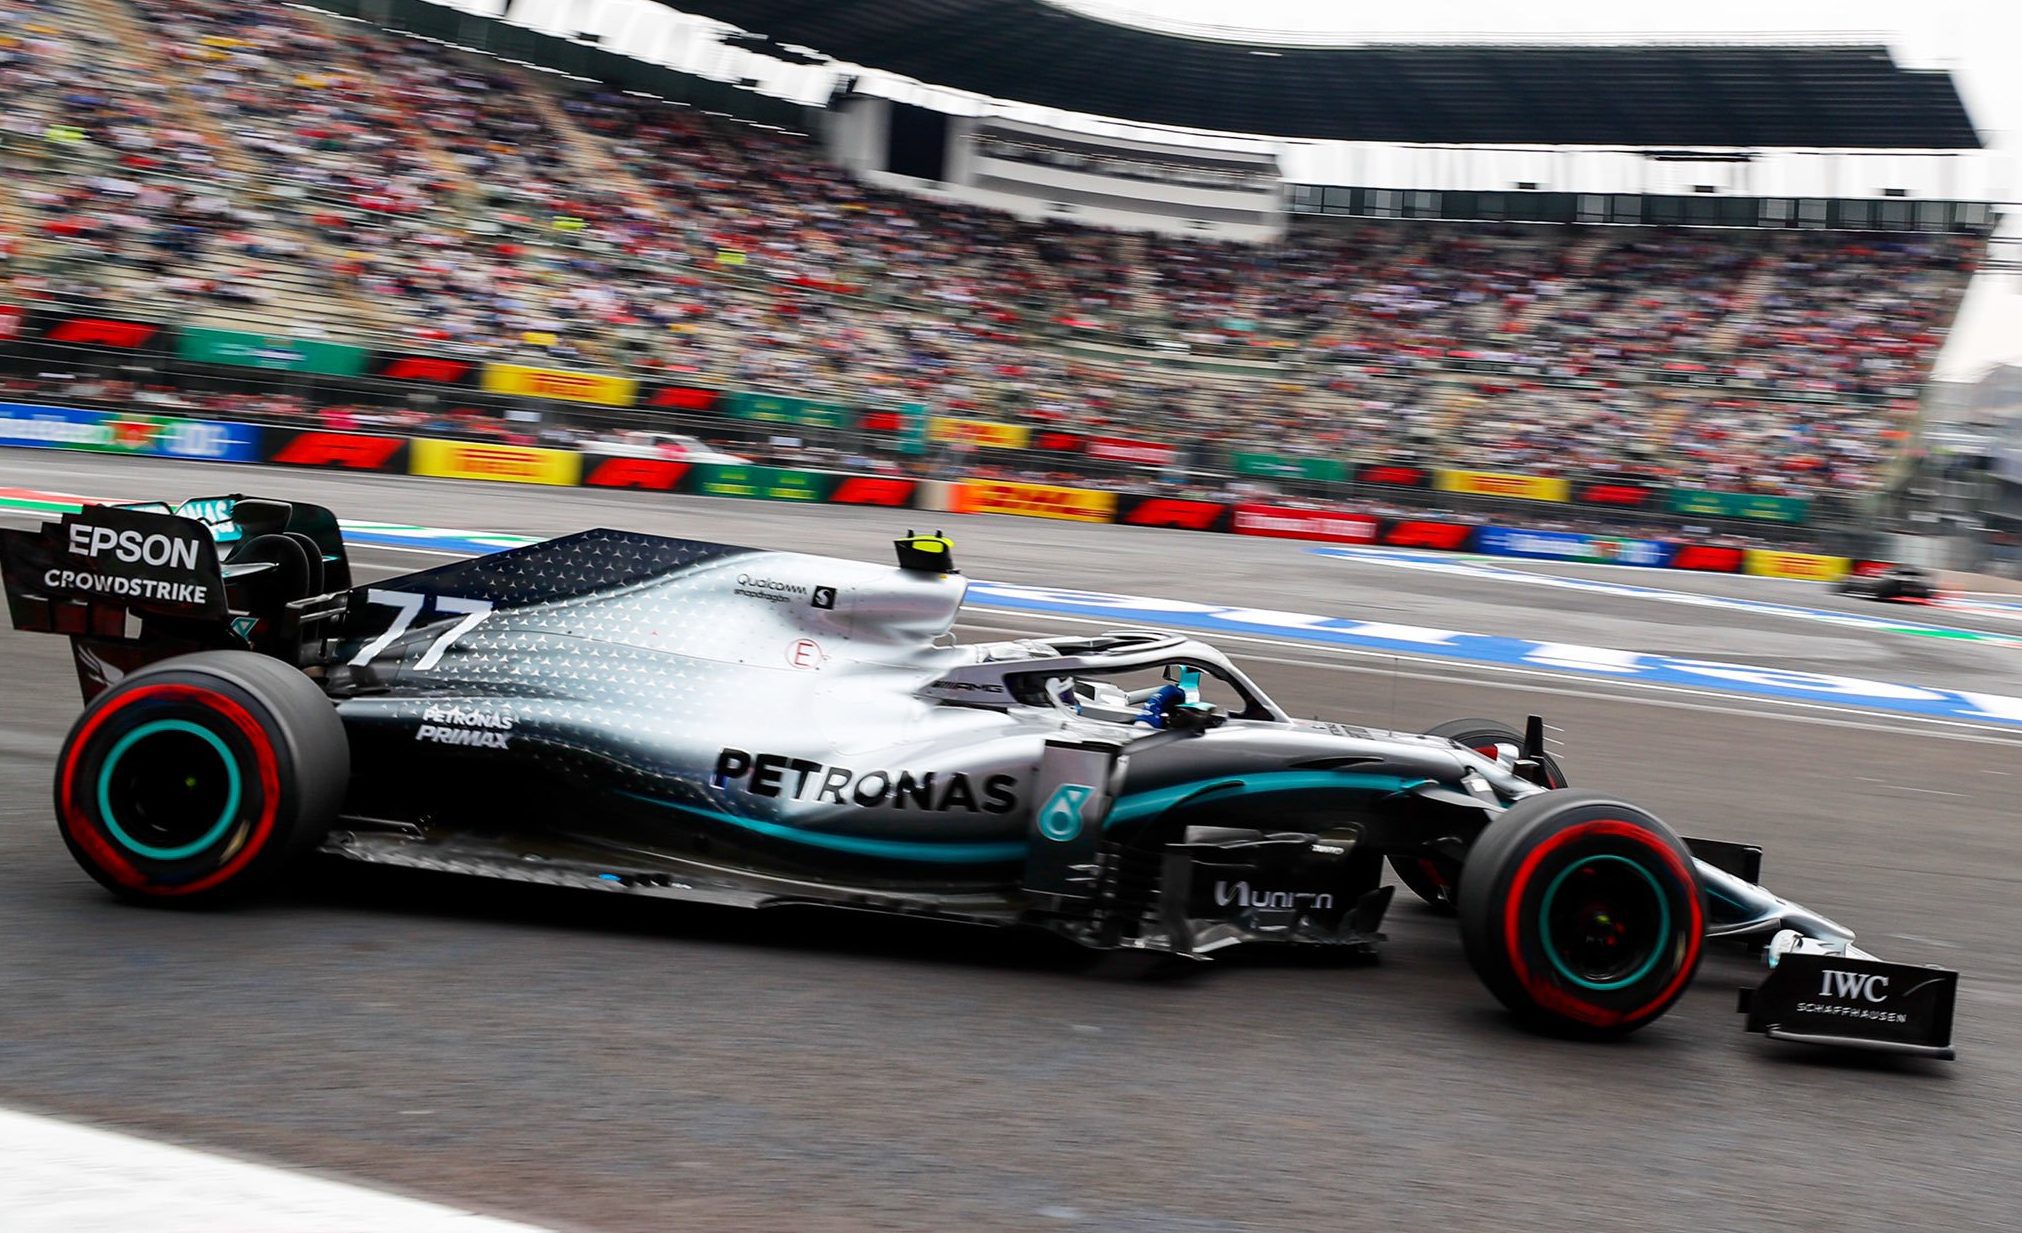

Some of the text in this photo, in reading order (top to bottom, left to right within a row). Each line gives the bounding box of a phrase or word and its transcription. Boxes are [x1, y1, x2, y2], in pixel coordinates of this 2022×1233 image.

[69, 523, 199, 570] EPSON
[44, 569, 207, 604] CROWDSTRIKE
[347, 588, 493, 671] 77
[794, 642, 815, 667] E
[423, 707, 514, 730] PETRONAS
[415, 725, 510, 750] PRIMAX
[711, 746, 1019, 815] PETRONAS
[1818, 969, 1889, 1003] IWC
[1796, 1002, 1908, 1024] SCHAFFHAUSEN
